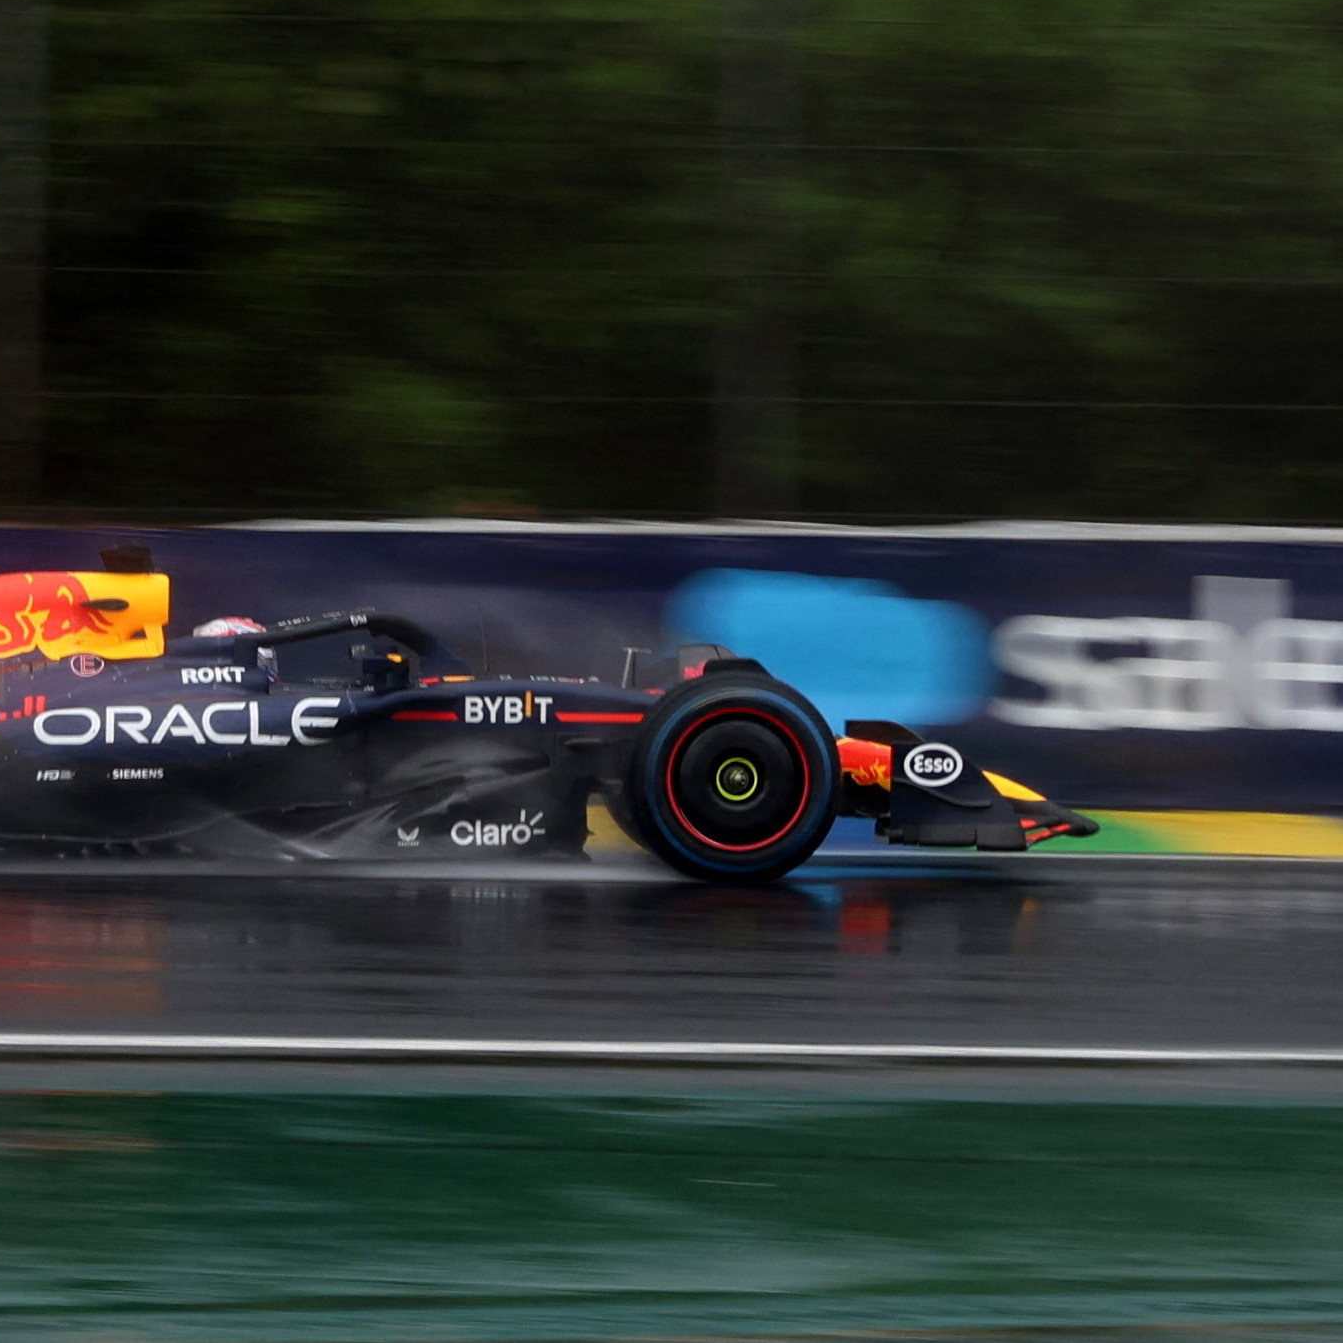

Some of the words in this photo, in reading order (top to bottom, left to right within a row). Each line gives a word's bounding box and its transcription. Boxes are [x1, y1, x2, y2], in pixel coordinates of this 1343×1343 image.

[181, 666, 246, 685] ROKT
[464, 690, 553, 724] BYBIT
[33, 697, 342, 746] ORACLE
[112, 768, 164, 780] SIEMENS
[914, 754, 954, 774] Esso
[451, 818, 532, 846] Claro
